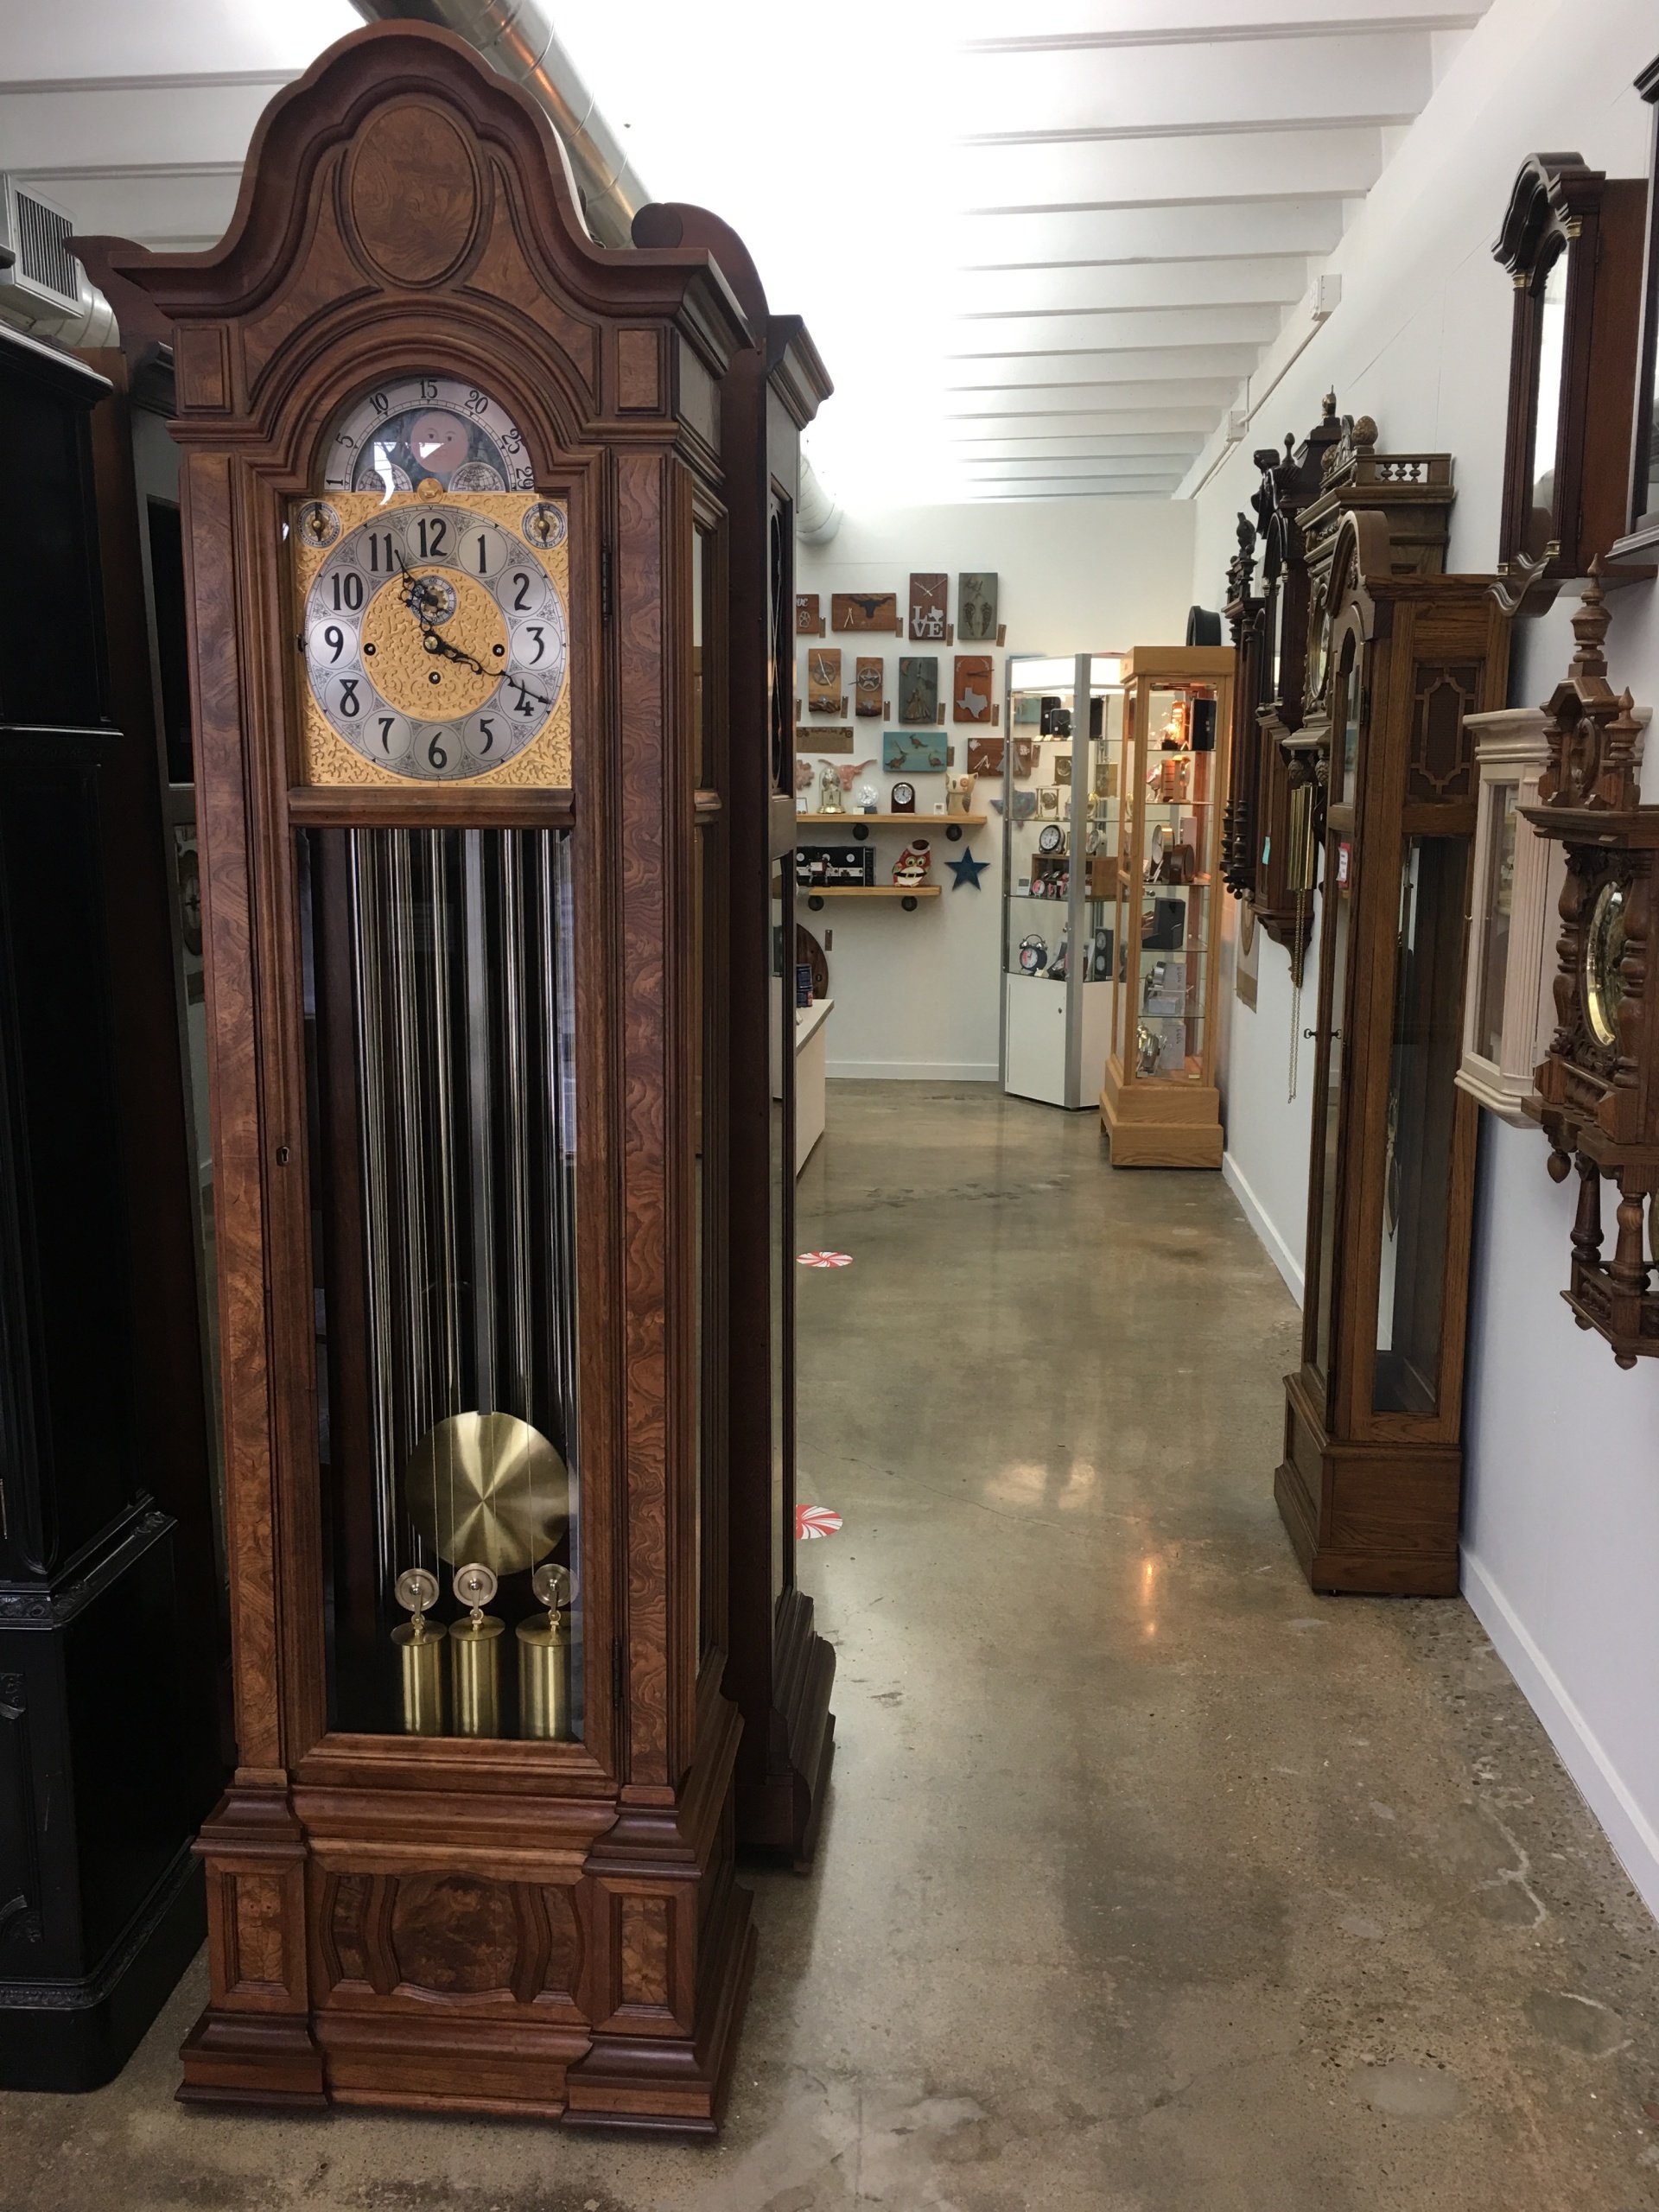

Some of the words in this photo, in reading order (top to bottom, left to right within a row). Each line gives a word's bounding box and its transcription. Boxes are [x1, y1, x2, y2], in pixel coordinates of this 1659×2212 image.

[369, 392, 389, 415] 10
[420, 379, 438, 399] 15
[464, 390, 489, 415] 20
[335, 433, 354, 448] 5
[501, 428, 522, 454] 25
[516, 467, 535, 490] 29
[369, 532, 394, 572] 11
[417, 518, 448, 558] 12
[478, 534, 487, 573] 1
[331, 572, 363, 611] 10
[513, 572, 533, 612] 2
[324, 626, 345, 664] 9
[526, 626, 544, 664] 3
[339, 678, 360, 717] 8
[513, 679, 535, 716] 4
[378, 717, 396, 754] 7
[428, 731, 448, 769] 6
[480, 718, 495, 754] 5
